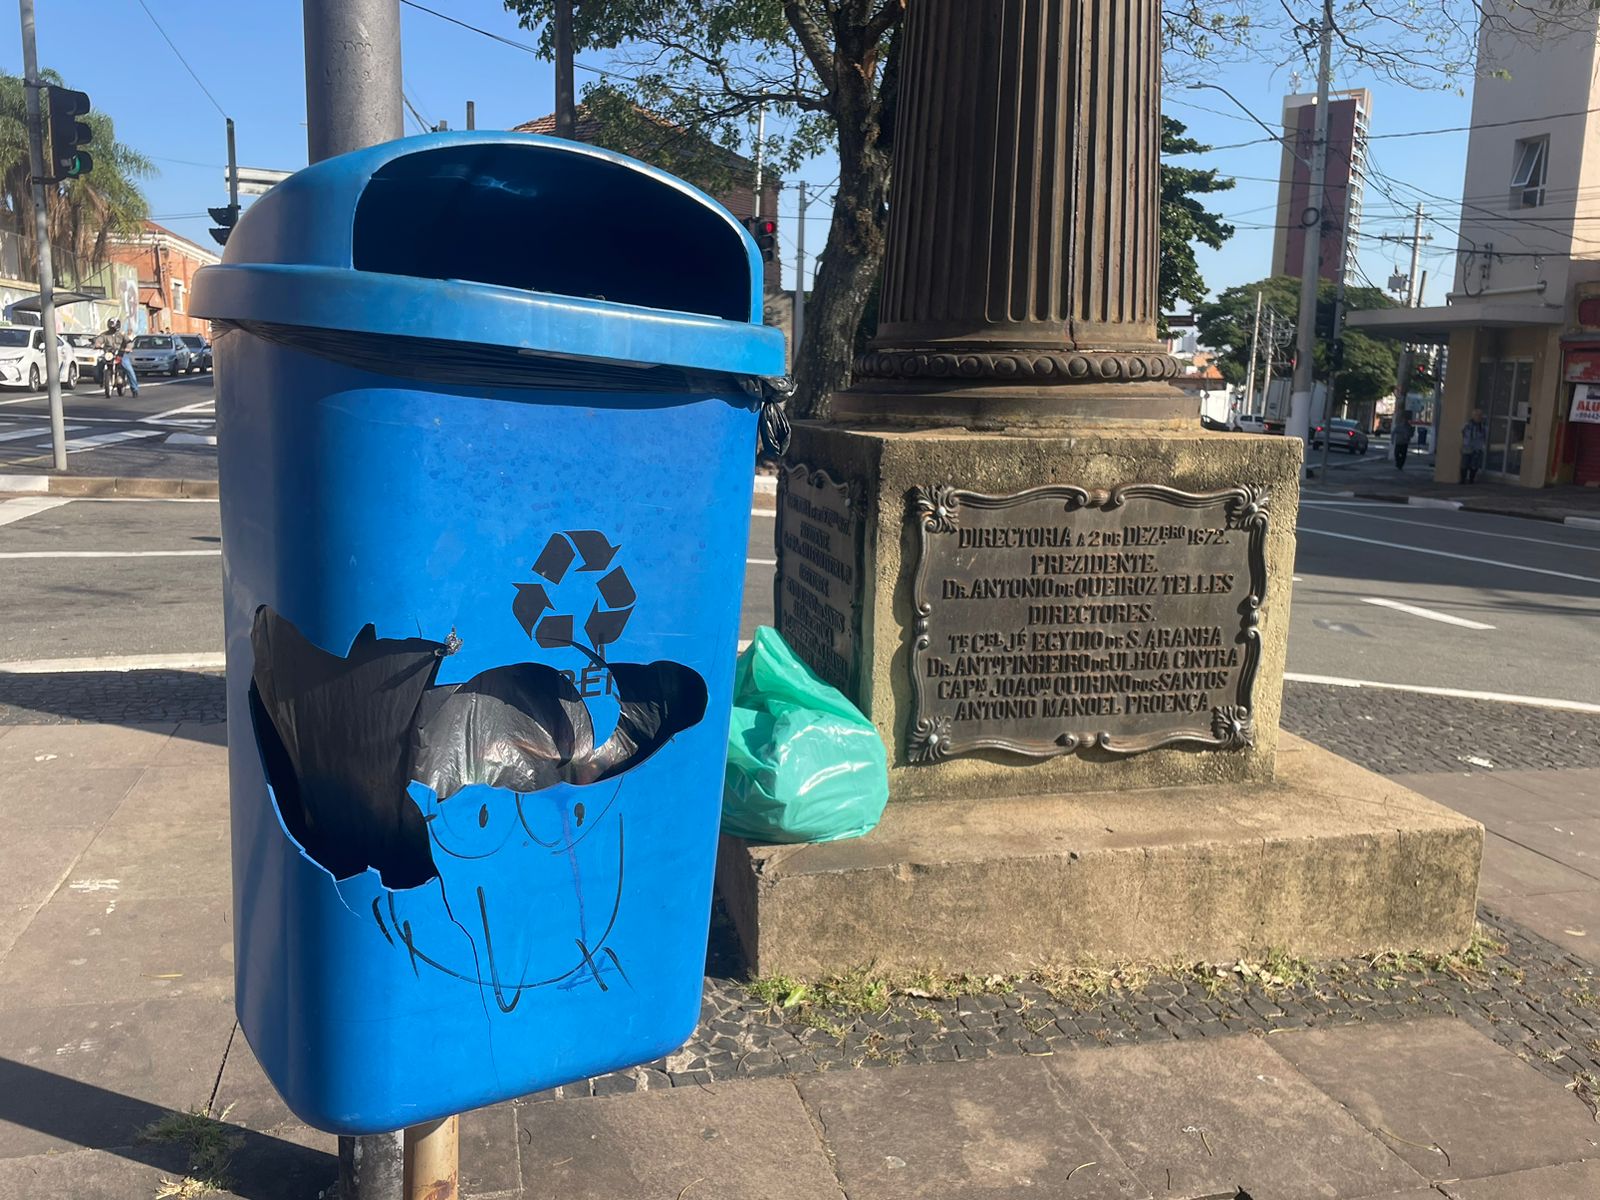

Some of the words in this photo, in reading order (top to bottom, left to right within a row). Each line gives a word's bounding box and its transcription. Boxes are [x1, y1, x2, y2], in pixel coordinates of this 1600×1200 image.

[958, 526, 1073, 549] DIRECTORIA
[1087, 530, 1101, 547] 2
[1102, 531, 1122, 546] DE
[1030, 553, 1159, 575] PREZIDENTE.
[970, 577, 1053, 600] ANTONIO
[1074, 576, 1159, 599] QUEIROZ
[1161, 573, 1234, 596] TELLES
[1028, 604, 1157, 626] DIRECTORES.
[1104, 635, 1124, 650] DE
[1143, 626, 1222, 649] ARANHA
[1000, 653, 1091, 675] PINHEIRO
[1108, 650, 1169, 671] ULHOA
[1173, 648, 1239, 669] CINTRA
[1053, 673, 1132, 697] QUIRINO
[1158, 670, 1229, 691] SANTOS
[954, 700, 1037, 722] ANTONIO
[1124, 692, 1209, 716] PROENÇA
